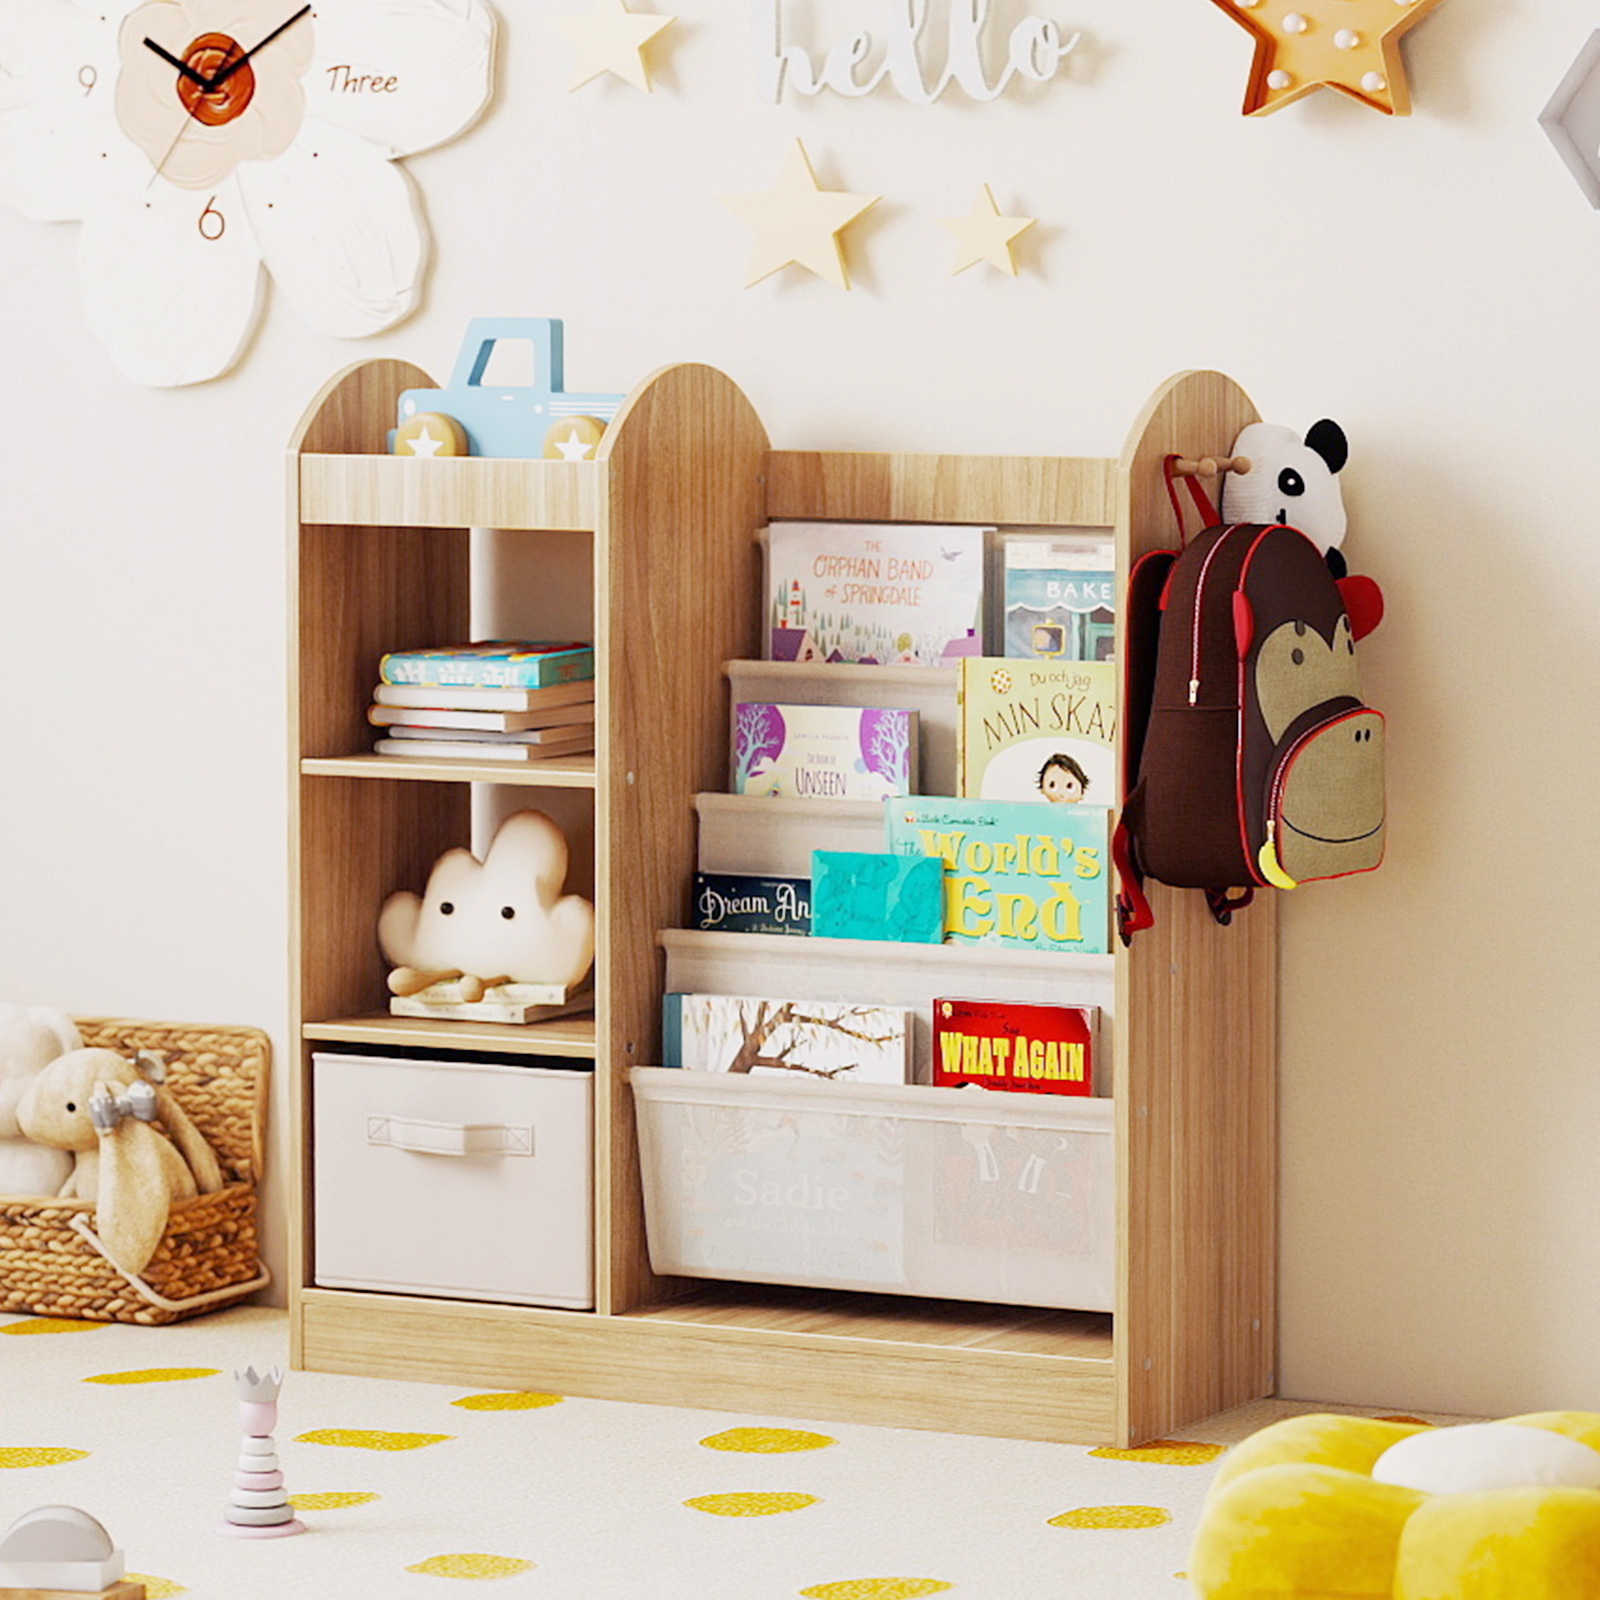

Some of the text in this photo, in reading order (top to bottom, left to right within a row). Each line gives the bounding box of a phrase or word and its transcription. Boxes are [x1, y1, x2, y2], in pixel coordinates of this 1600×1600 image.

[752, 0, 1081, 105] hello
[78, 65, 97, 97] 9
[326, 65, 399, 93] Three
[198, 195, 225, 241] 6
[865, 540, 883, 553] THE
[813, 554, 934, 581] ORPHAN BAND
[824, 583, 923, 606] of SPRINGDALE
[1046, 581, 1112, 600] BAKE
[1029, 670, 1092, 692] Du och jag
[983, 697, 1040, 750] MIN
[795, 767, 847, 796] UNSEEN
[917, 829, 1101, 879] World's
[699, 886, 771, 929] Dream
[943, 875, 1084, 943] End
[939, 1031, 1085, 1083] WHAT AGAIN
[733, 1168, 850, 1212] Sadie
